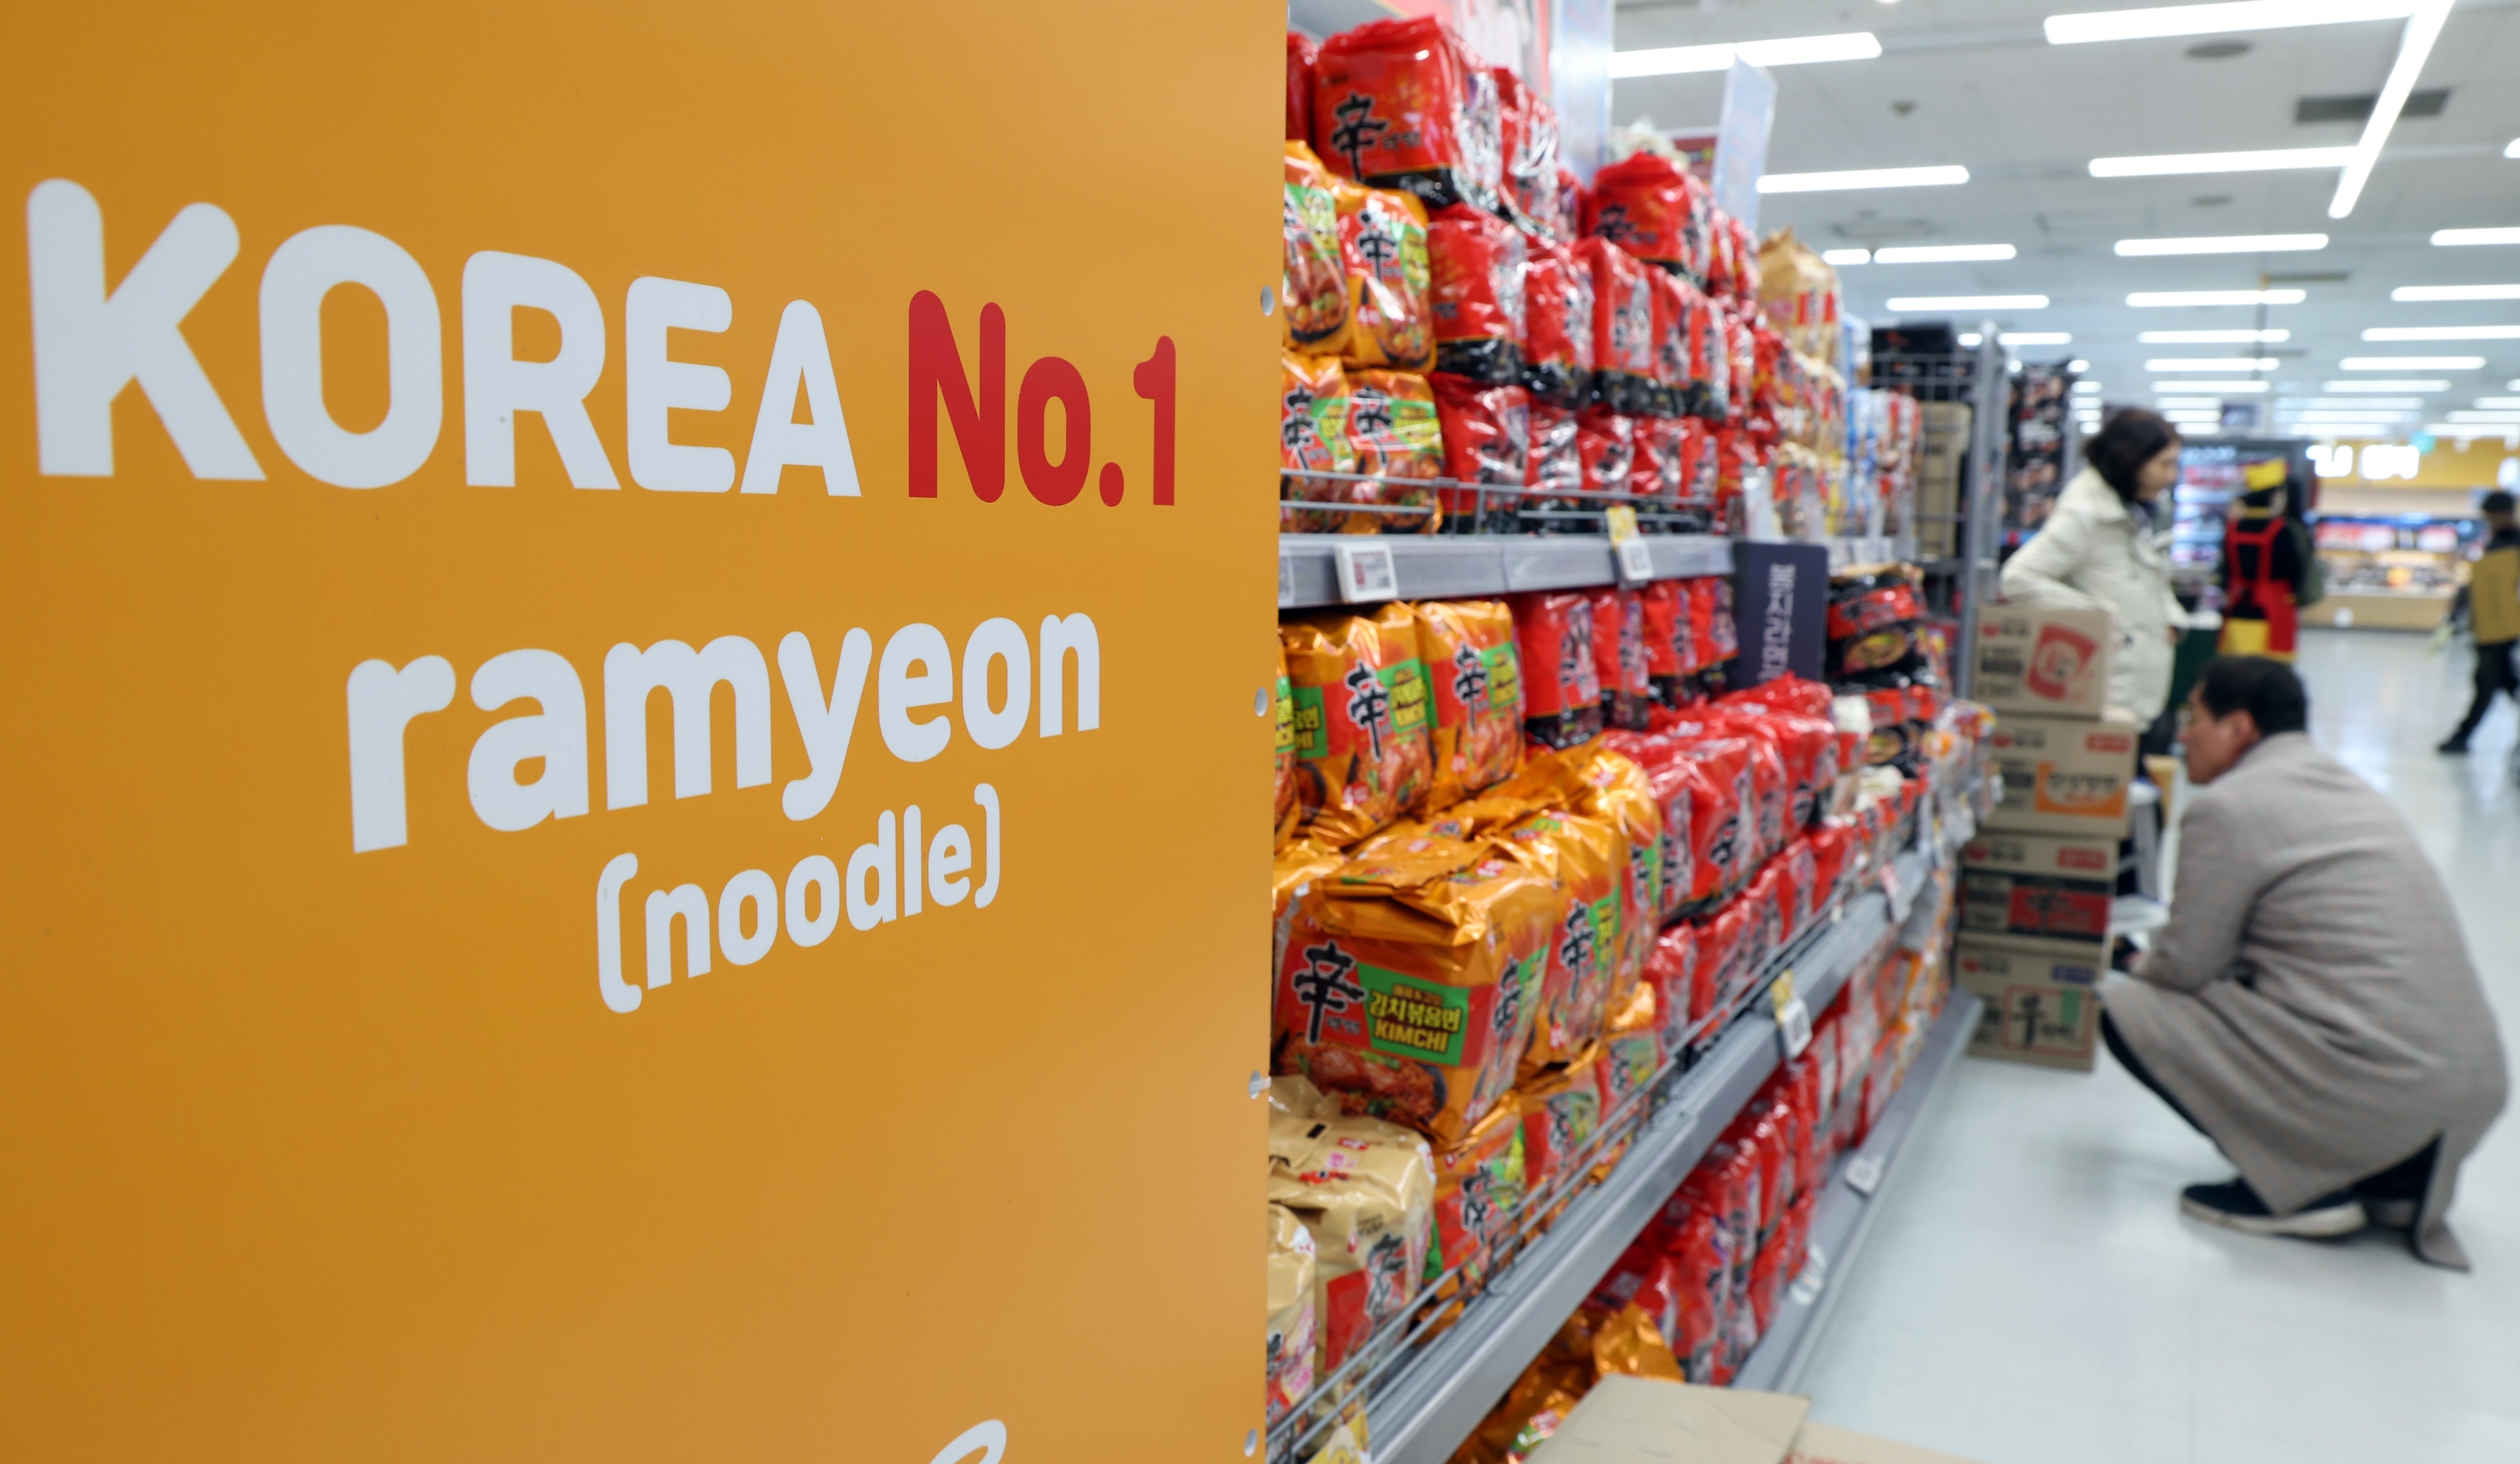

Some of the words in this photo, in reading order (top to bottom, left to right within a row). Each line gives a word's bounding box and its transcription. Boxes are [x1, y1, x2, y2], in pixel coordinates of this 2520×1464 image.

[1332, 93, 1390, 182] 辛
[27, 179, 861, 497] KOREA
[909, 290, 1175, 506] No.1
[347, 613, 1100, 853] ramyeon
[1345, 659, 1390, 763] 辛
[1454, 643, 1487, 735] 辛
[596, 783, 1000, 1013] (noodle)
[1292, 941, 1367, 1046] 辛
[1369, 990, 1462, 1032] 김치볶음면
[1374, 1019, 1449, 1053] KIMCHI
